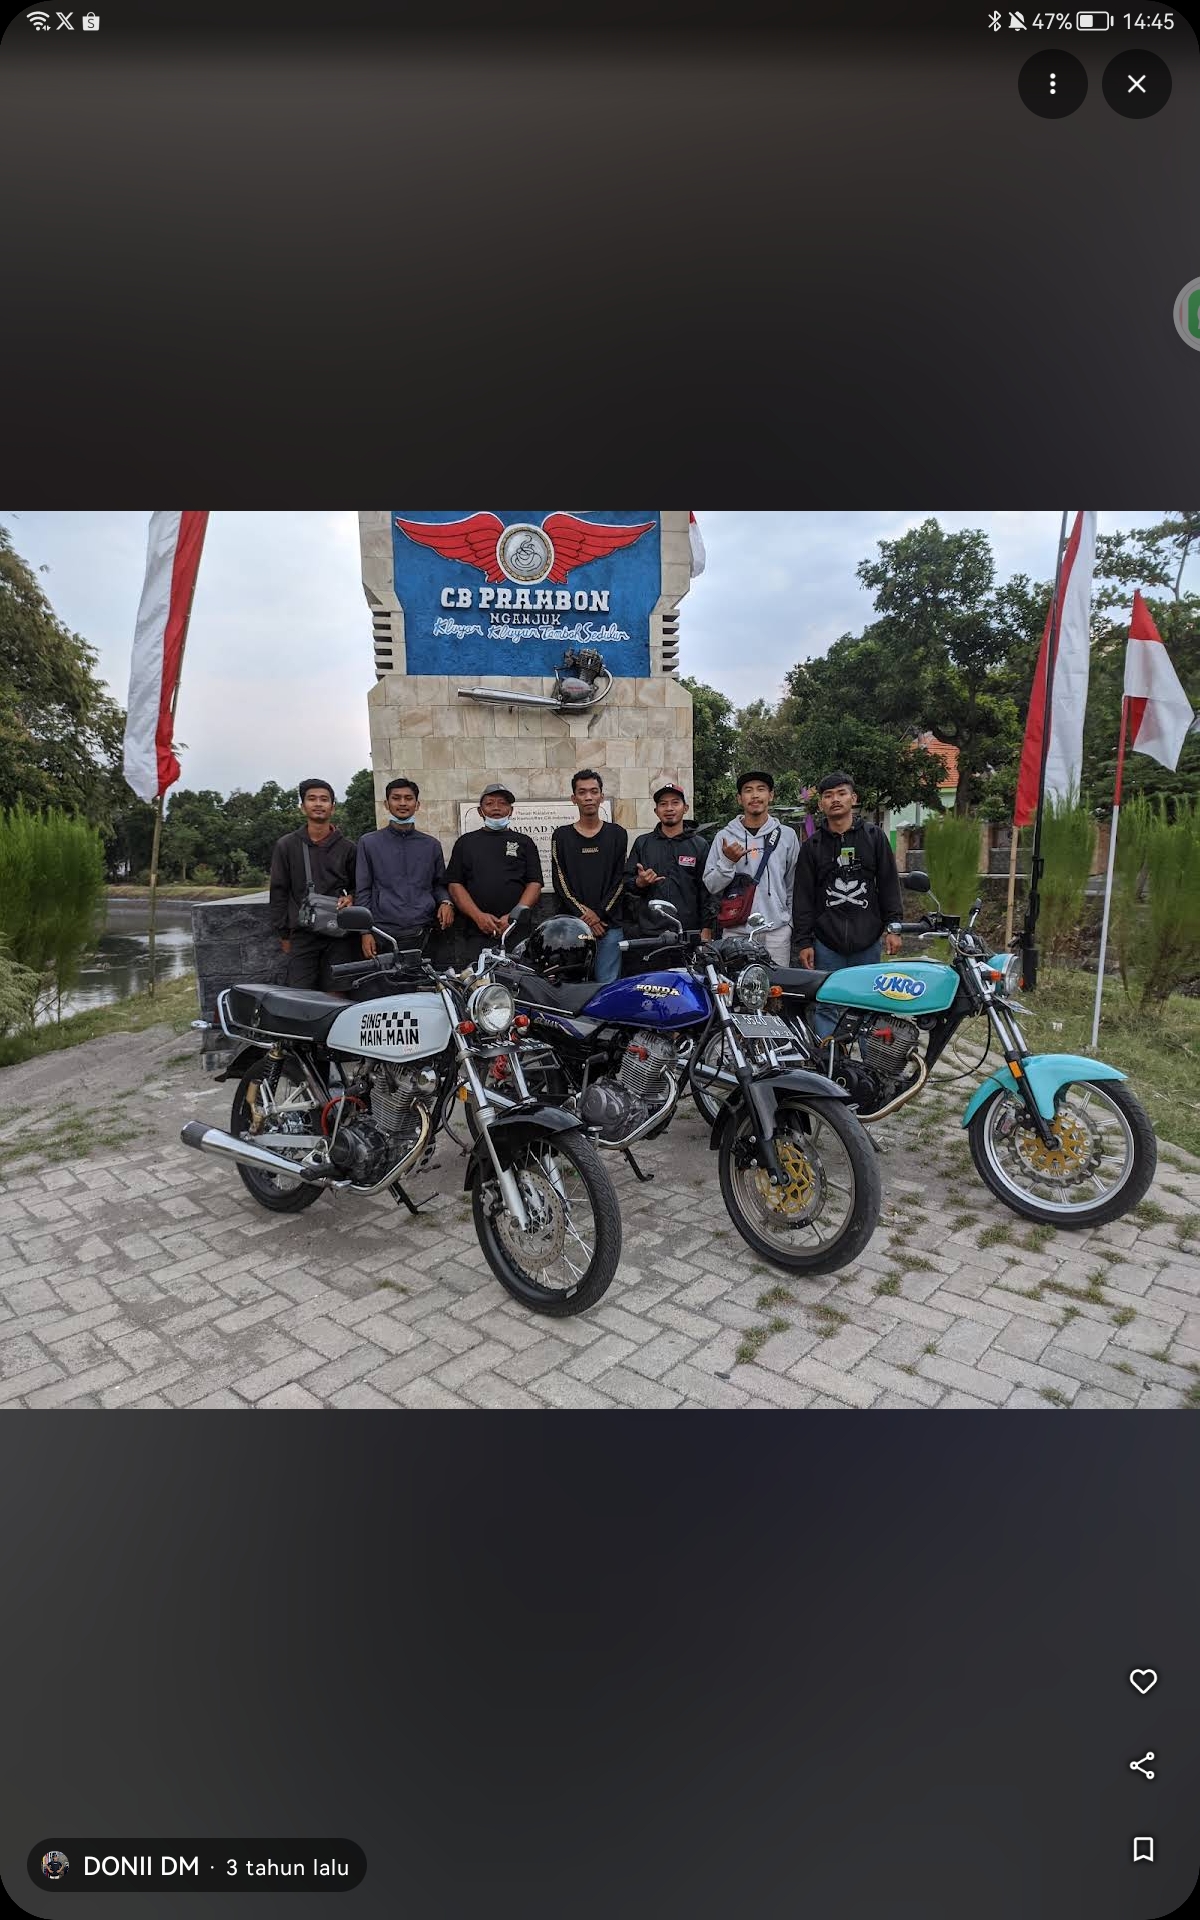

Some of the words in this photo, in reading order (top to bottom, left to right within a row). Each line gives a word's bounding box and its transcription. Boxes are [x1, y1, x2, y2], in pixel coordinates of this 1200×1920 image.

[440, 587, 472, 608] CB
[479, 587, 610, 611] PRAMBON
[490, 612, 561, 625] NGANJUK
[636, 984, 680, 996] HONDA
[874, 974, 926, 997] SUKRO
[361, 1013, 381, 1029] SING
[360, 1028, 419, 1046] MAIN-MAIN
